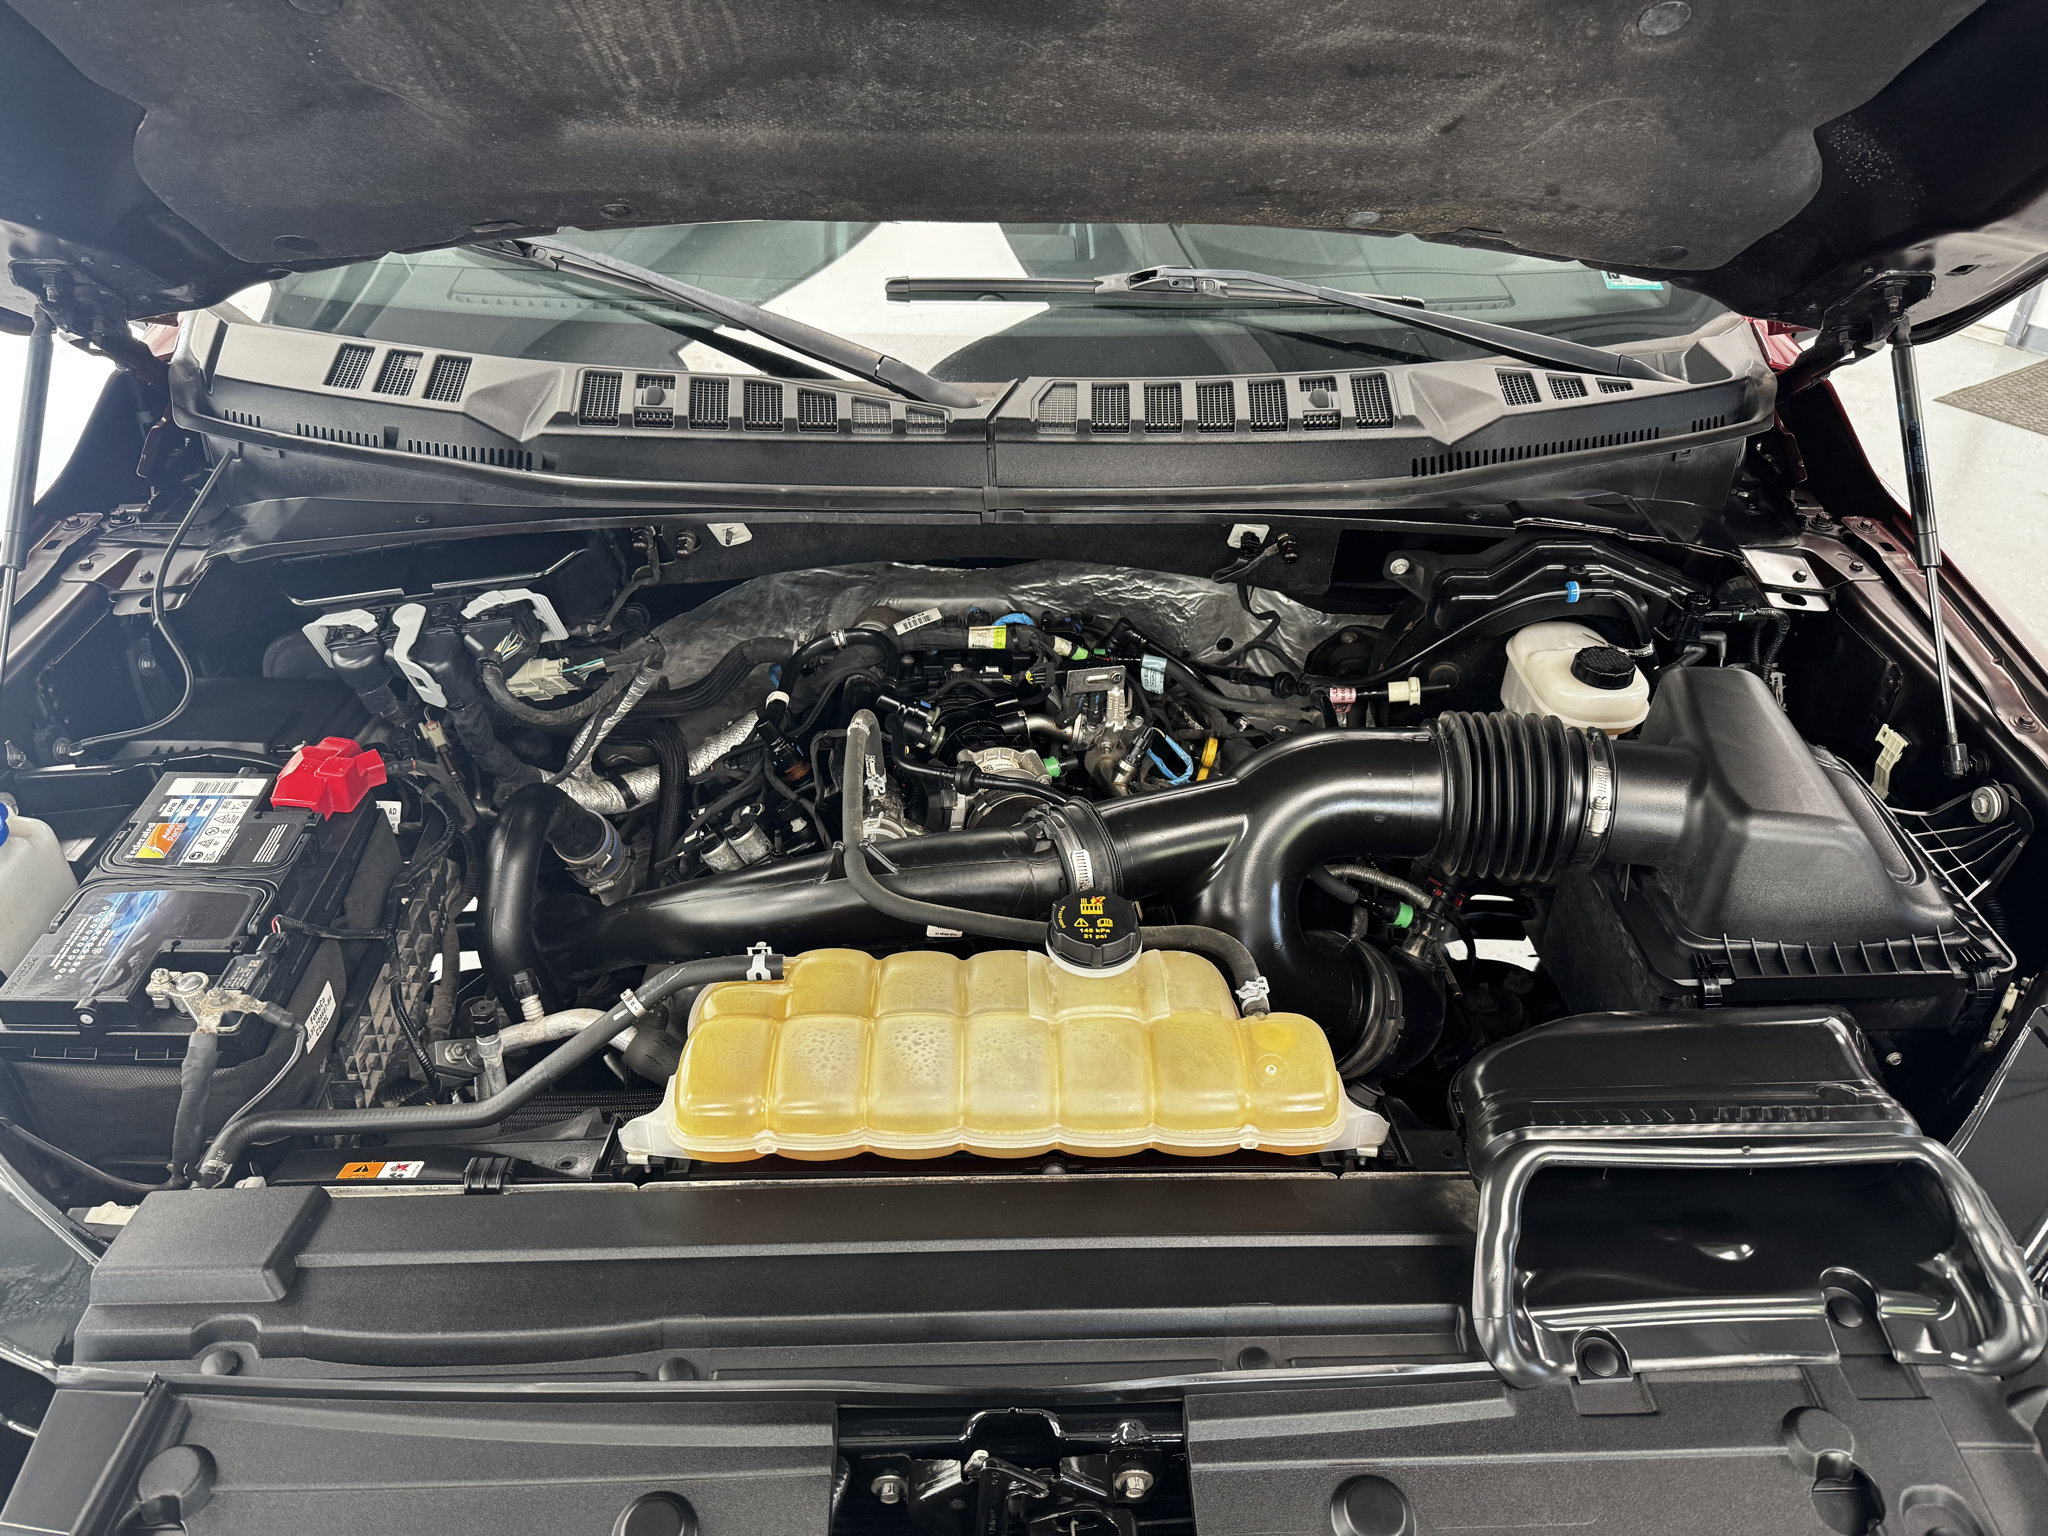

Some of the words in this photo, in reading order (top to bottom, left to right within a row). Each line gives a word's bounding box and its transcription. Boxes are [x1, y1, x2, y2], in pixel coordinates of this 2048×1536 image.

[124, 822, 158, 859] Federated
[161, 824, 176, 839] Auto
[166, 824, 185, 842] Parts
[309, 997, 325, 1025] FoMoCo
